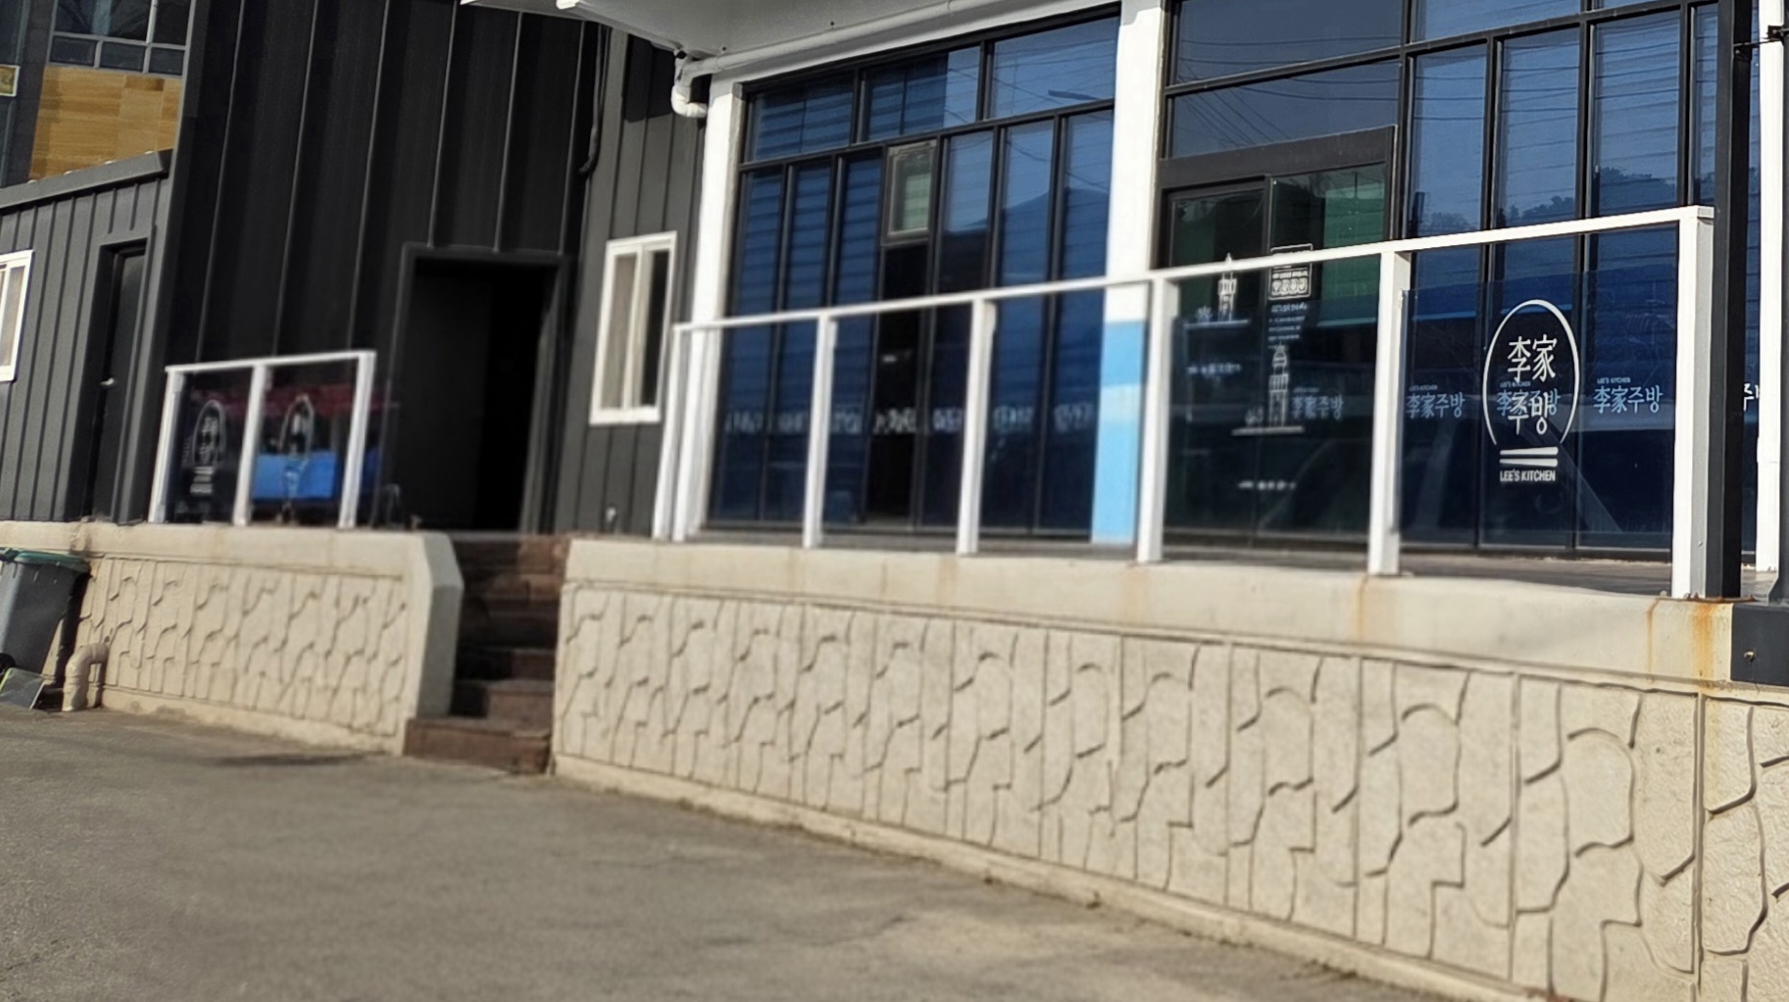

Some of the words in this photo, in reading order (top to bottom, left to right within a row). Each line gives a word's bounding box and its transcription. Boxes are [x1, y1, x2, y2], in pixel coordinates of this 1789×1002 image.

[1508, 334, 1557, 384] 李家
[1406, 391, 1466, 419] 李家주방
[1508, 392, 1549, 435] 주방
[1593, 385, 1663, 414] 李家주방
[1500, 470, 1521, 482] LEE'S
[1521, 469, 1556, 482] KITCHEN
